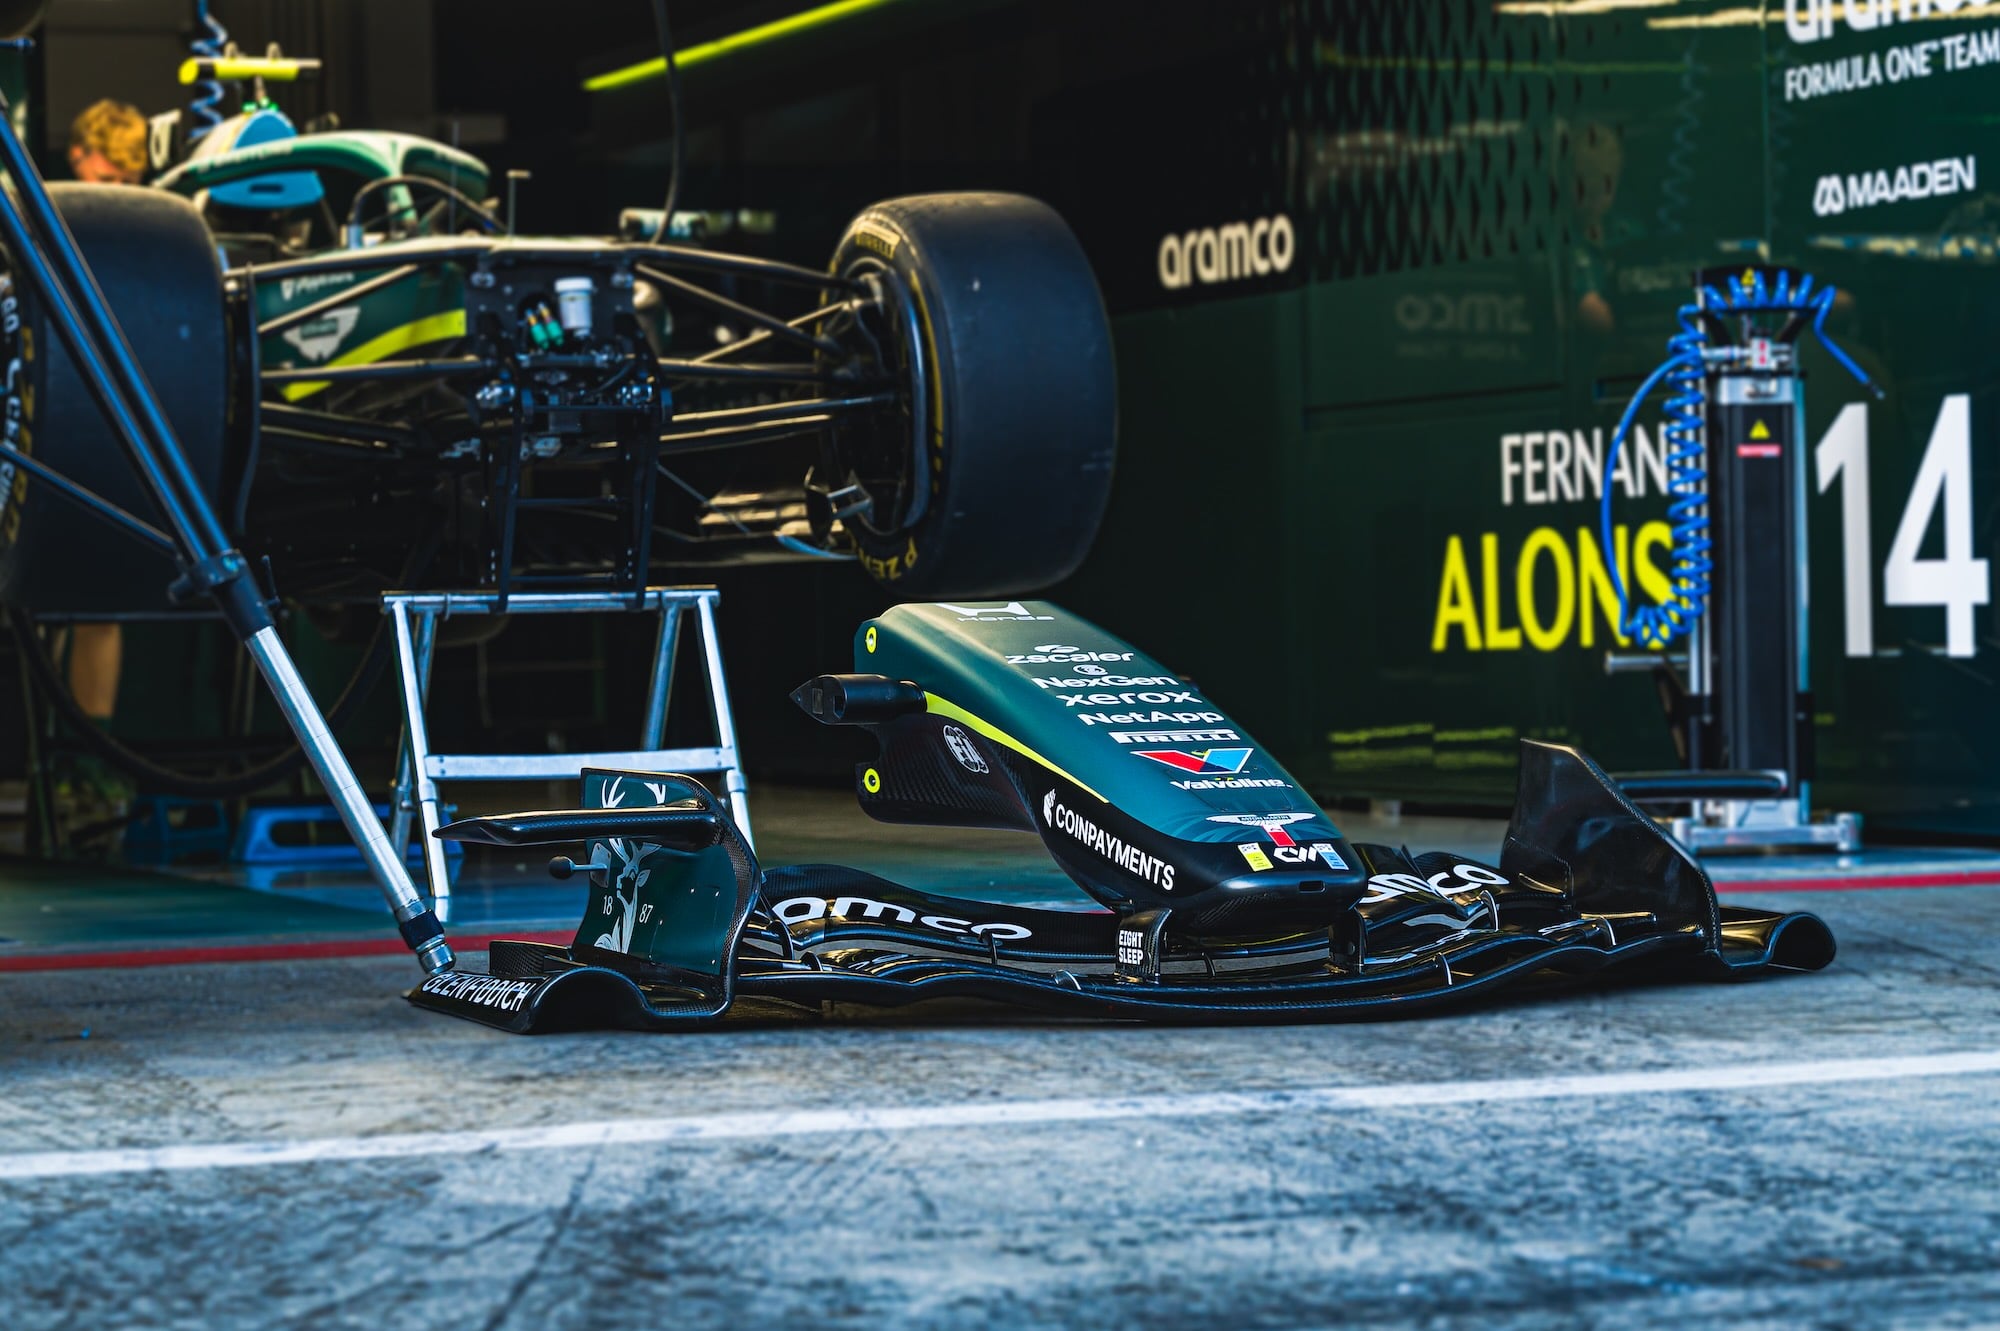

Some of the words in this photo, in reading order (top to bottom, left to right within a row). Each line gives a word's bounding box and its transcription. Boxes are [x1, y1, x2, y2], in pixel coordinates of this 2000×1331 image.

[1785, 53, 1883, 102] FORMULA
[1942, 28, 2000, 72] TEAM
[1847, 157, 1976, 208] MAADEN
[1159, 214, 1295, 289] aramco
[1815, 394, 1990, 657] 14
[1431, 521, 1686, 651] ALONS
[1005, 651, 1134, 665] zscaler
[1030, 674, 1179, 690] NexGen
[1056, 691, 1203, 707] xerox
[1077, 710, 1225, 726] NetApp
[1108, 729, 1241, 744] PIRELLI
[1170, 778, 1287, 790] Valvoline
[1055, 803, 1176, 891] COINPAYMENTS
[602, 896, 613, 916] 18
[638, 904, 653, 924] 87
[1118, 930, 1143, 947] EIGHT
[1118, 947, 1144, 966] SLEEP
[421, 972, 537, 1012] GLENFIDDICH
